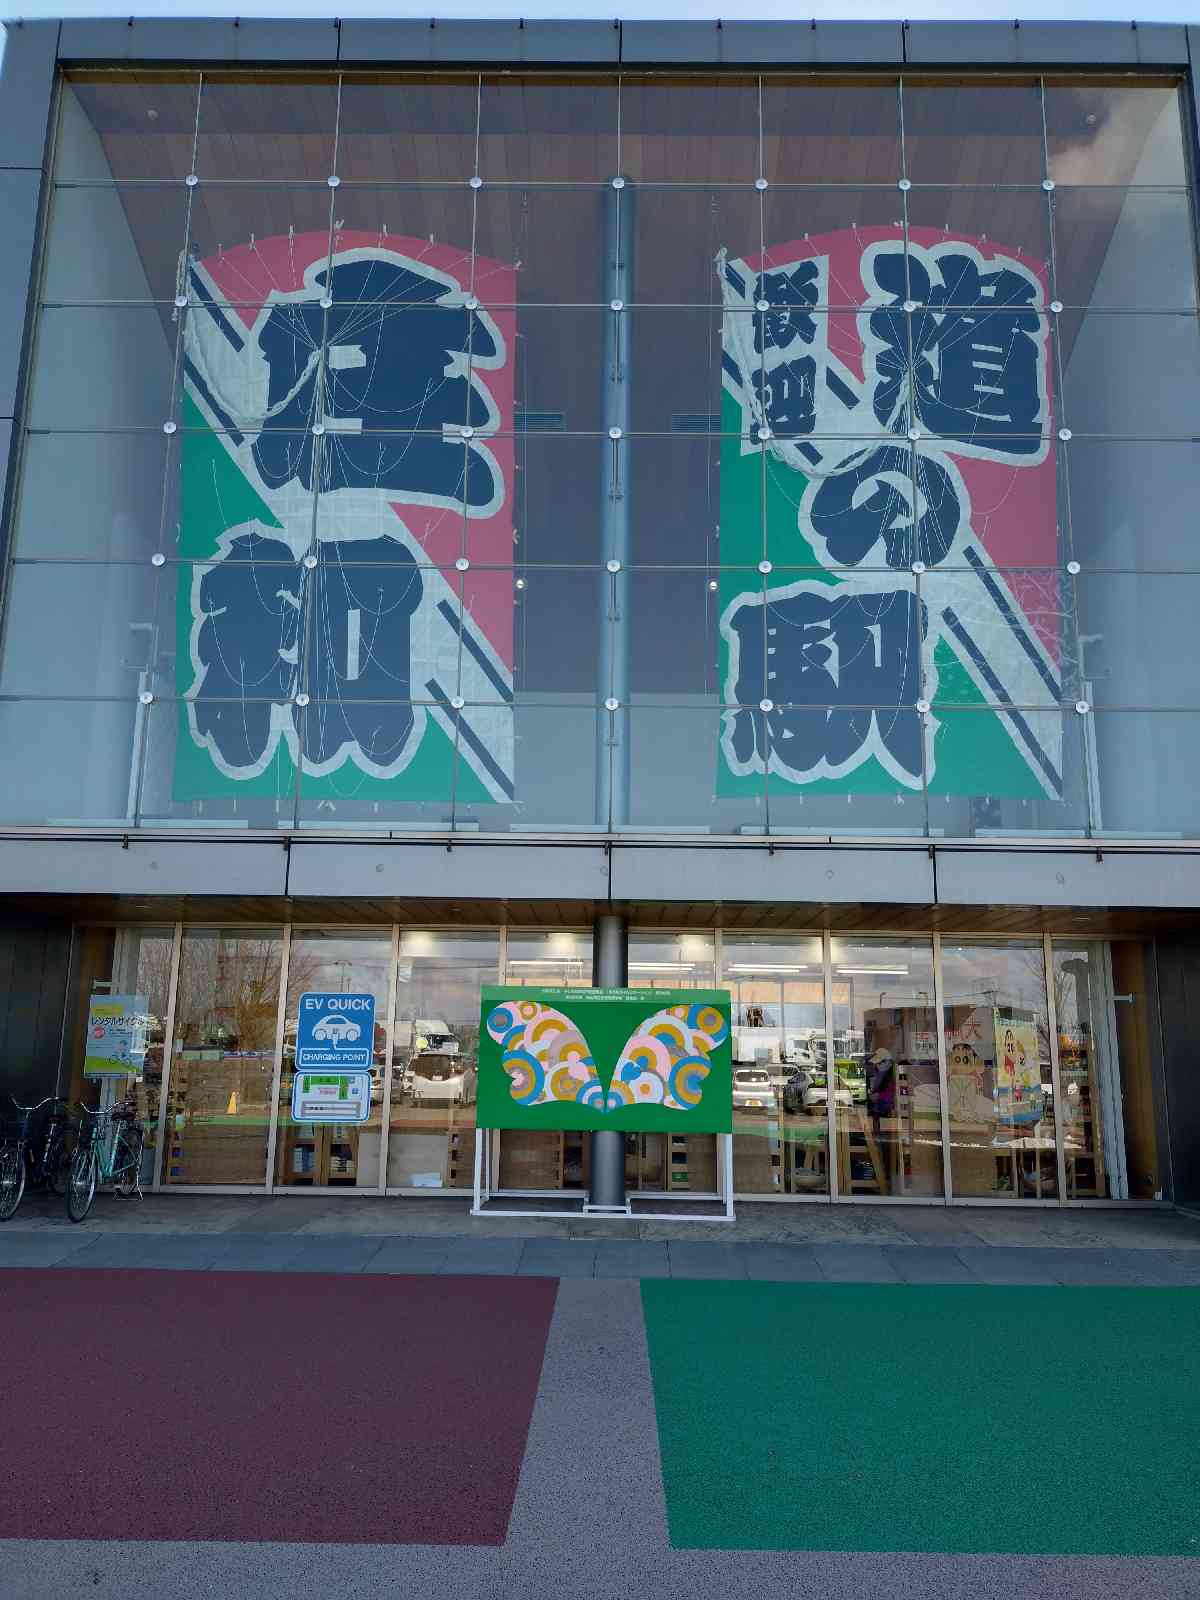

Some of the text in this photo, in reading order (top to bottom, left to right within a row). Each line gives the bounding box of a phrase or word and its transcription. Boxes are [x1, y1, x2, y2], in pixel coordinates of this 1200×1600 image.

[305, 998, 372, 1011] EV QUICK
[302, 1053, 366, 1061] CHARGING POINT
